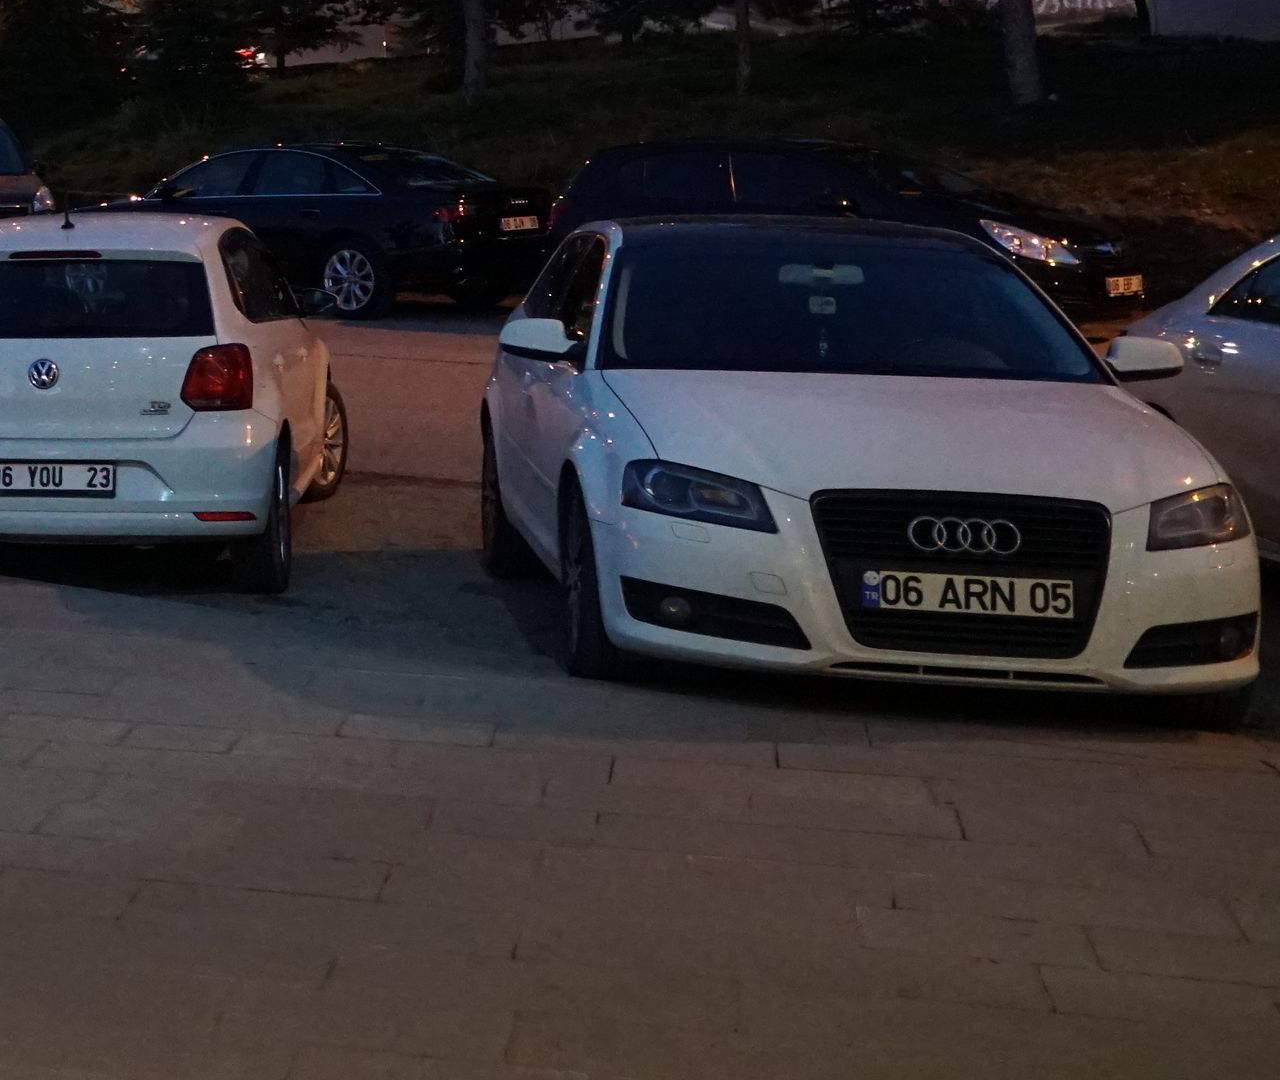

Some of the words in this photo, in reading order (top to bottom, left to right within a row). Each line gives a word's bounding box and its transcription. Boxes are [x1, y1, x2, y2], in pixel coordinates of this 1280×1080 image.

[28, 466, 63, 488] YOU
[87, 466, 111, 488] 23
[864, 591, 879, 601] TR
[881, 574, 924, 607] 06
[938, 577, 1015, 612] ARN
[1030, 582, 1071, 614] 05
